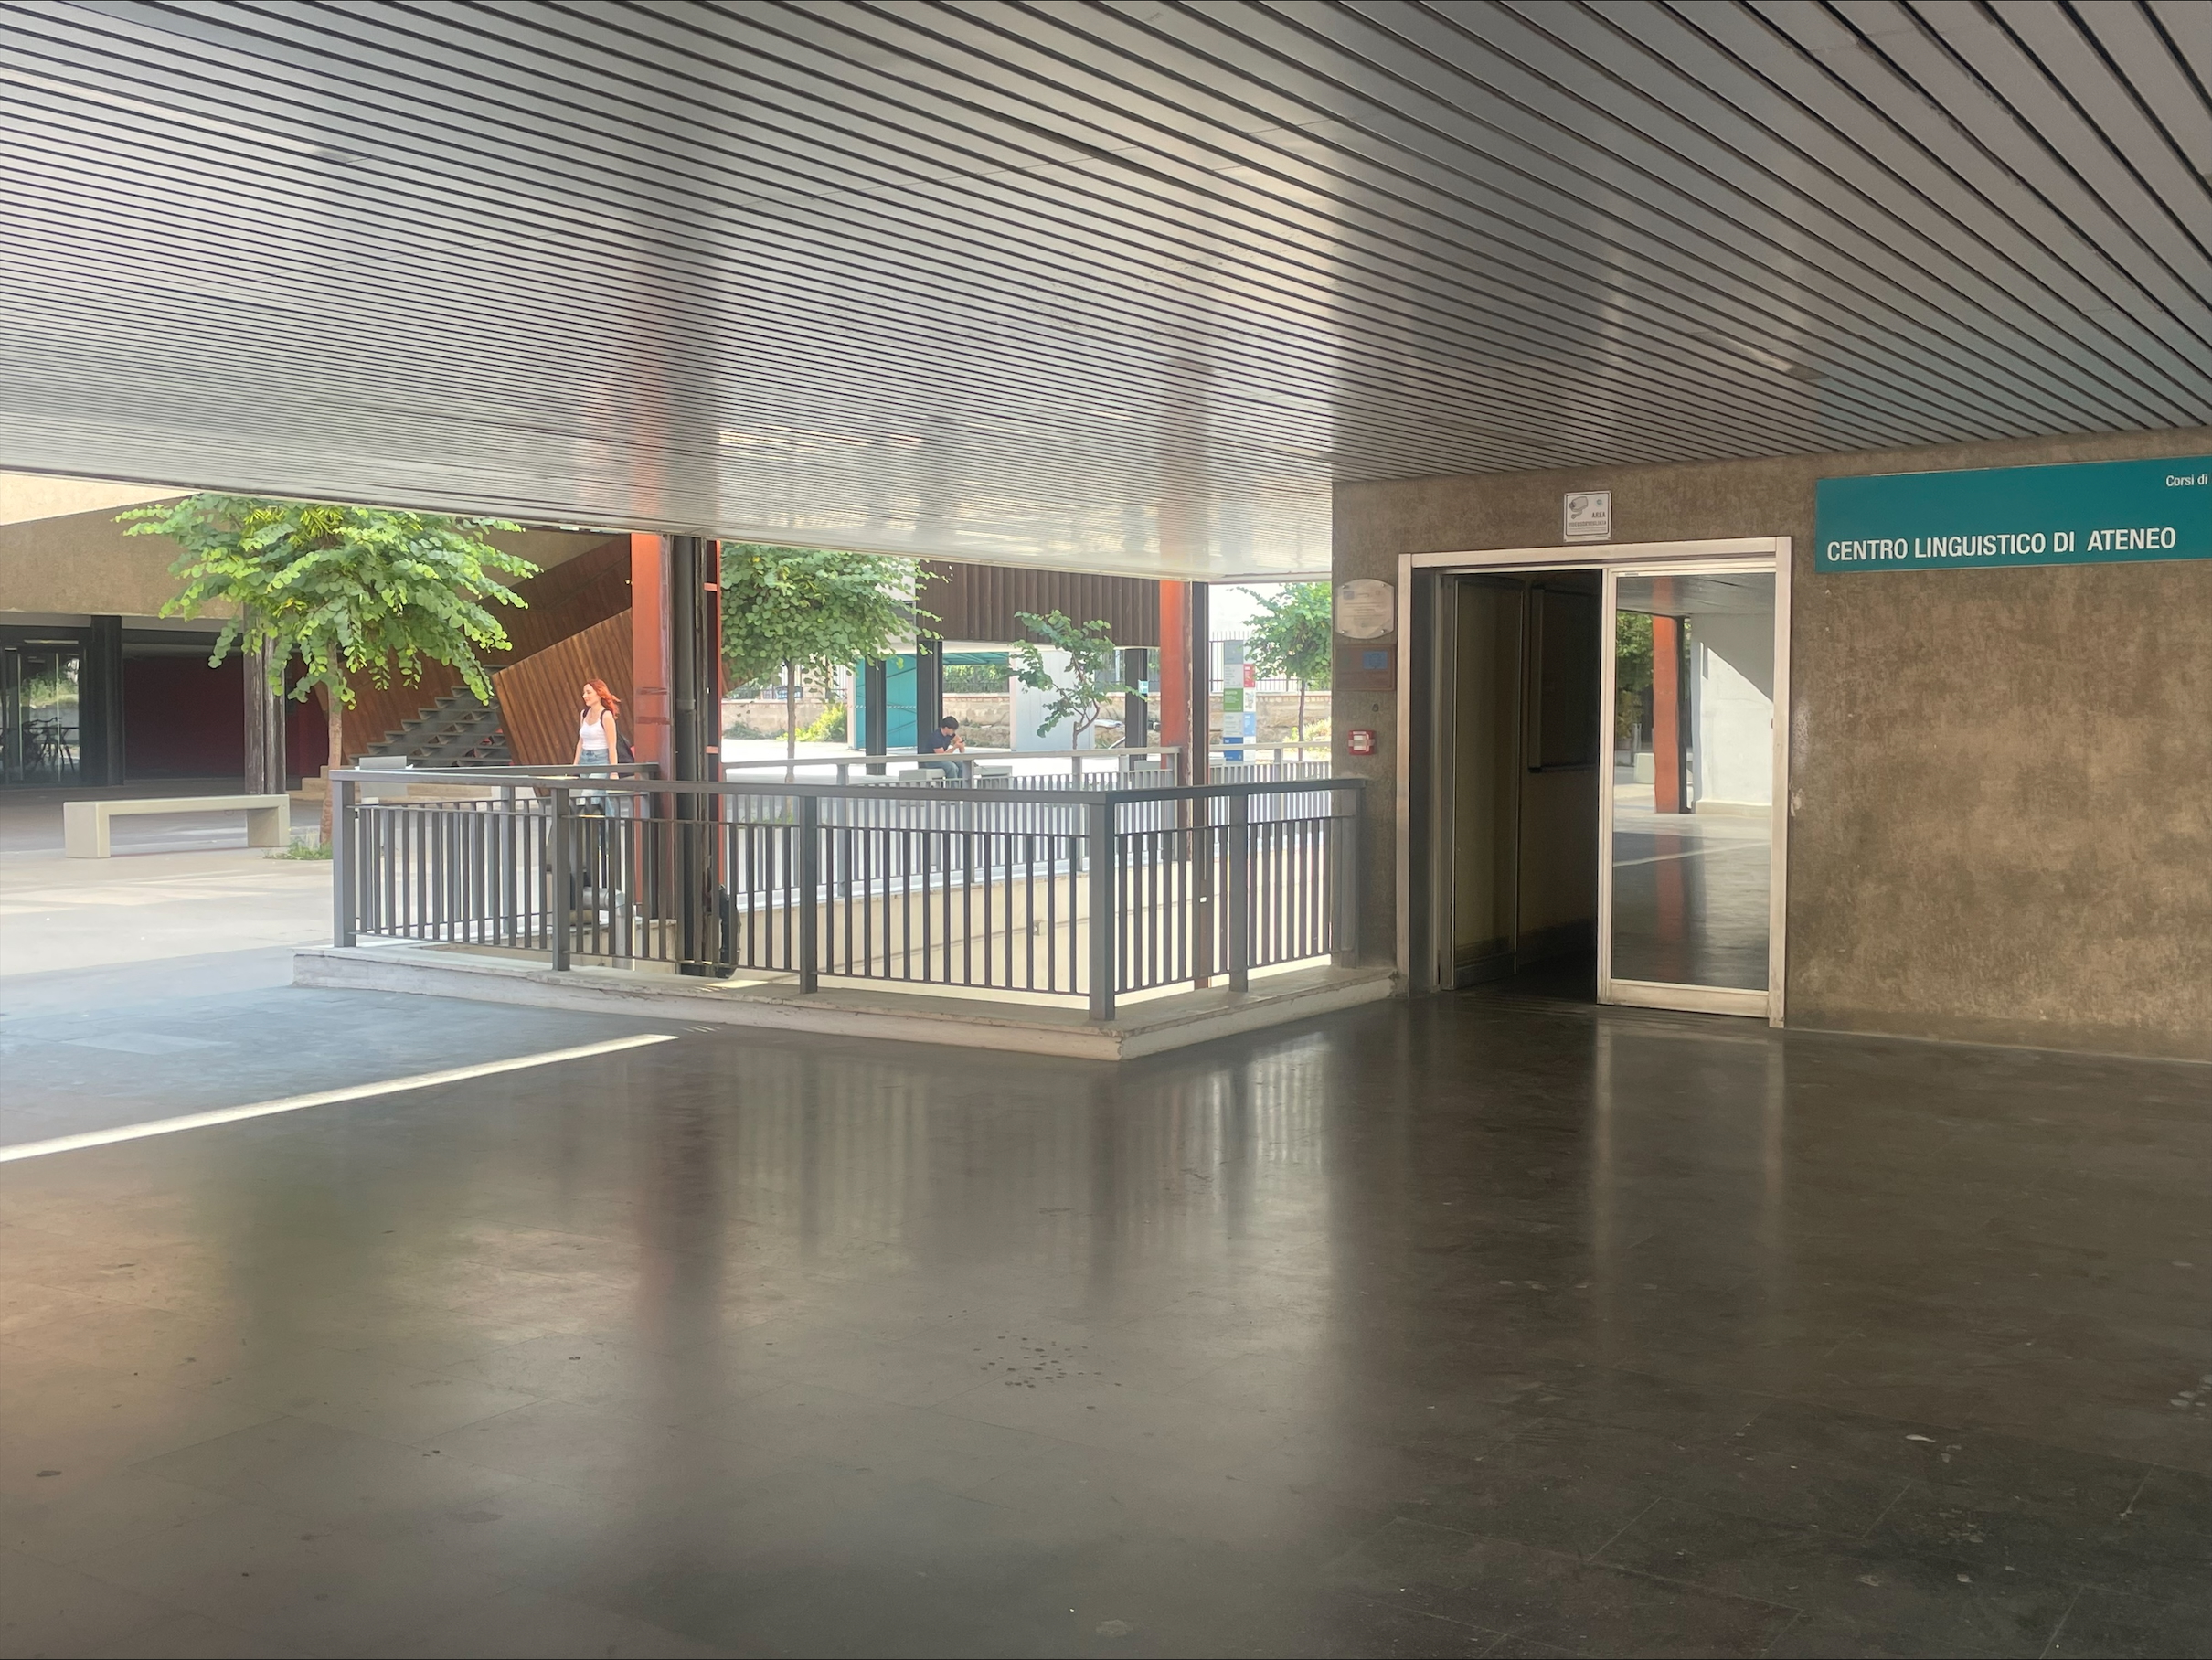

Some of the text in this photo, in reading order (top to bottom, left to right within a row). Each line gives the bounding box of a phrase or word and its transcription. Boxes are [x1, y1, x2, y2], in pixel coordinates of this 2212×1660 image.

[2165, 474, 2208, 487] Corsi di
[1827, 527, 2176, 561] CENTRO LINGUISTICO DI ATENEO
